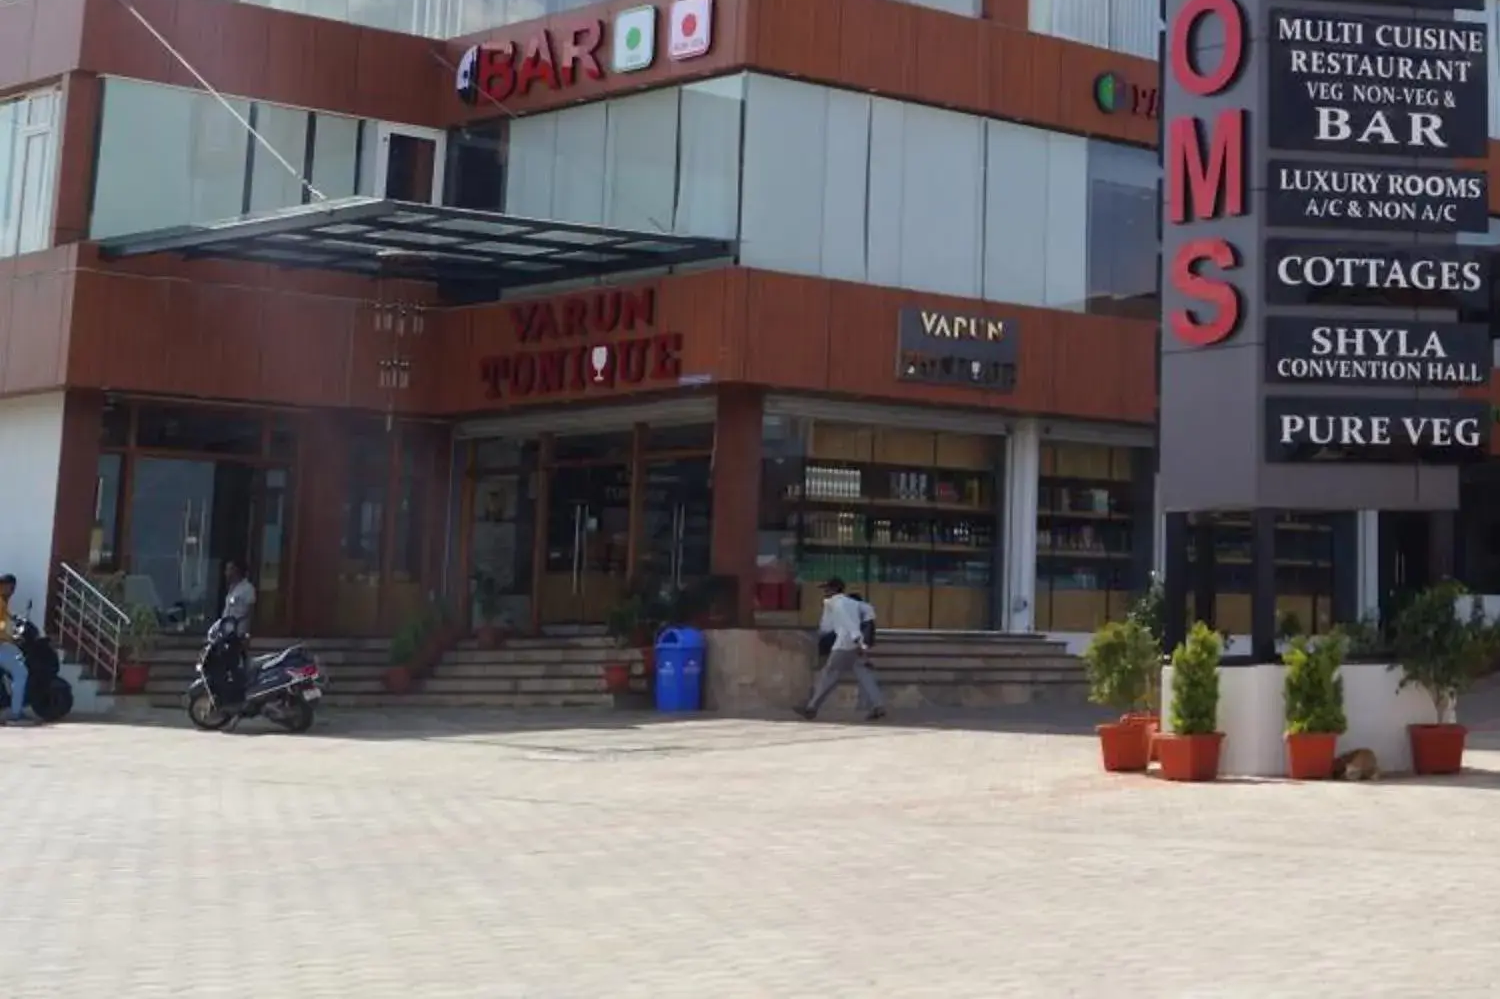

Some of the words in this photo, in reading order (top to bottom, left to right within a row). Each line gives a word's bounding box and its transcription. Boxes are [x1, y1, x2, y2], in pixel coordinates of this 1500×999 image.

[1279, 17, 1364, 44] MULTI
[1375, 24, 1483, 52] CUISINE
[478, 19, 606, 101] BAR
[1290, 50, 1472, 83] RESTAURANT
[1306, 80, 1343, 101] VEG
[1353, 84, 1438, 107] NON-VEG
[1443, 89, 1456, 108] &
[1314, 106, 1448, 148] BAR
[1280, 168, 1381, 194] LUXURY
[1388, 174, 1481, 199] ROOMS
[1305, 198, 1343, 218] A/C
[1347, 200, 1363, 218] &
[1368, 201, 1416, 221] NON
[1421, 204, 1457, 223] A/C
[1277, 256, 1482, 292] COTTAGES
[510, 287, 656, 345] VARUN
[1311, 326, 1447, 359] SHYLA
[1277, 357, 1421, 382] CONVENTION
[1426, 361, 1483, 383] HALL
[1279, 414, 1391, 446] PURE
[1402, 416, 1481, 448] VEG
